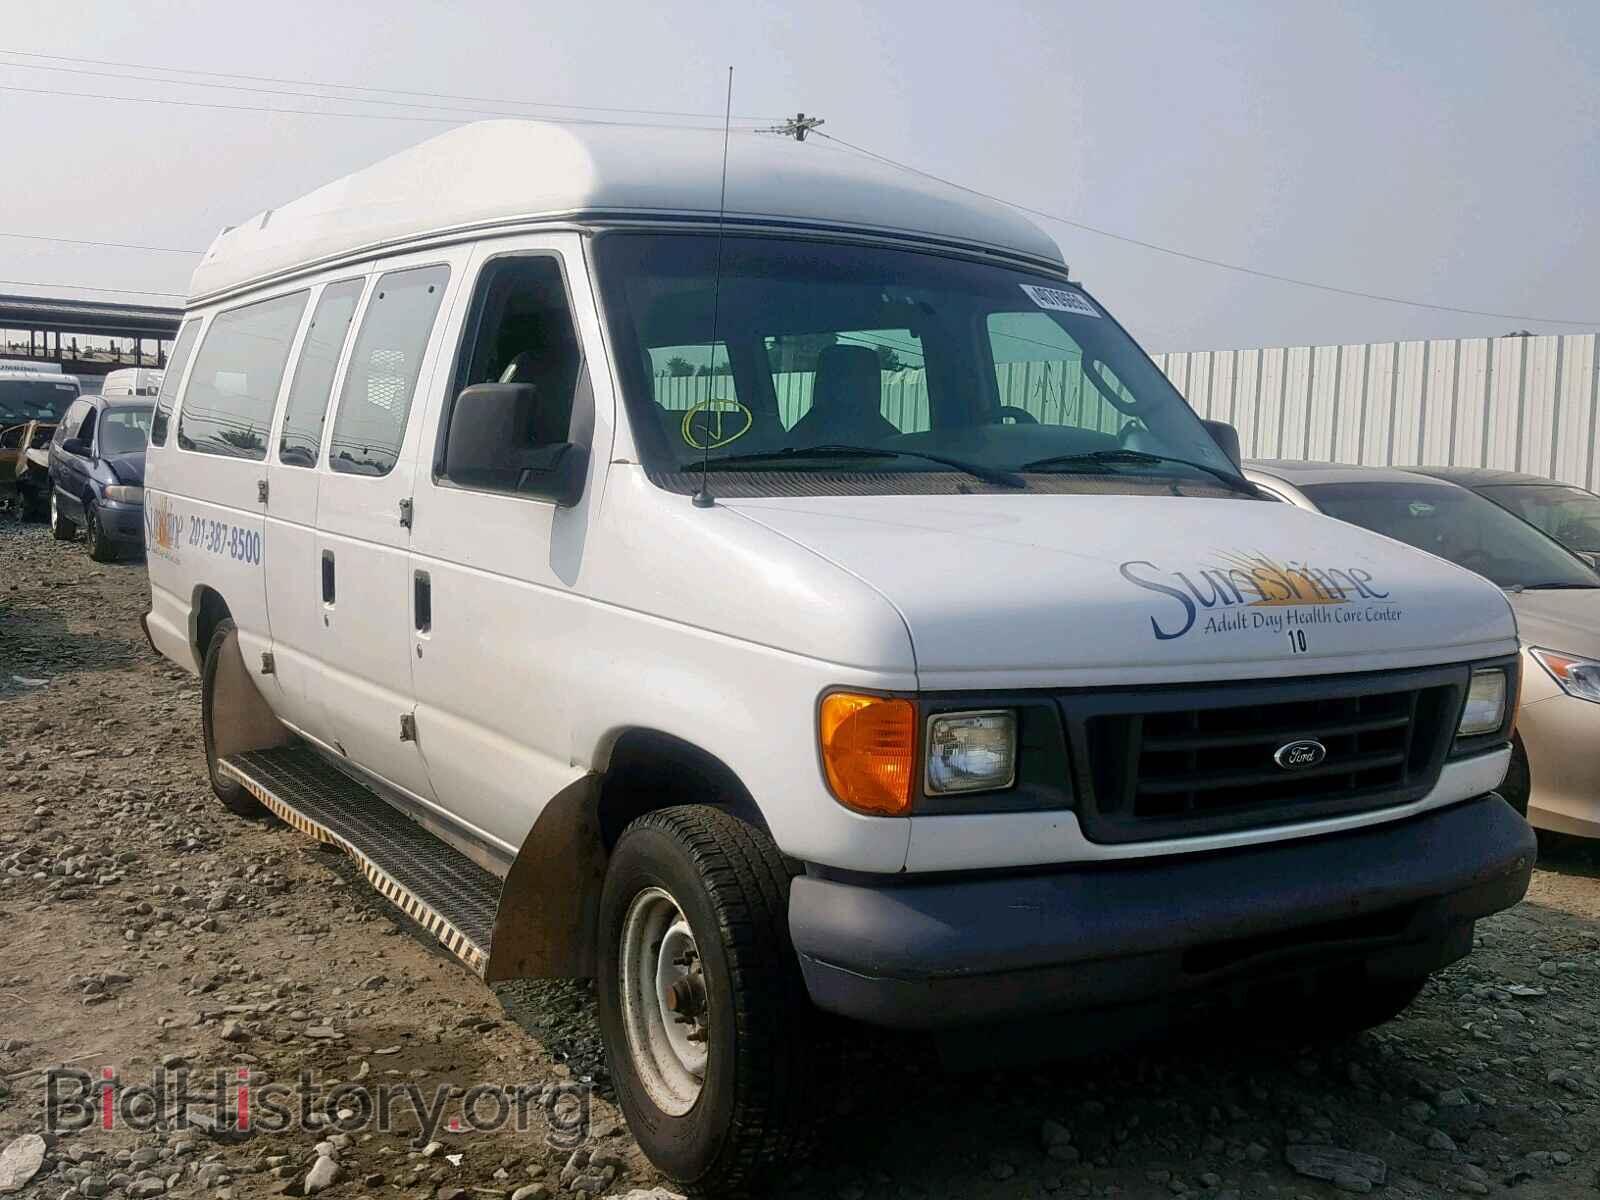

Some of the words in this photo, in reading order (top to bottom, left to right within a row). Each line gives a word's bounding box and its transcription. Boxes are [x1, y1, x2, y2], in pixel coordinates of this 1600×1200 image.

[1119, 559, 1390, 641] Sunshine
[1204, 613, 1248, 635] Adult
[1252, 610, 1283, 633] Day
[1286, 604, 1332, 625] Health
[1335, 606, 1362, 624] Care
[1365, 604, 1403, 623] Center
[1287, 628, 1308, 655] 10
[1288, 746, 1316, 764] Ford
